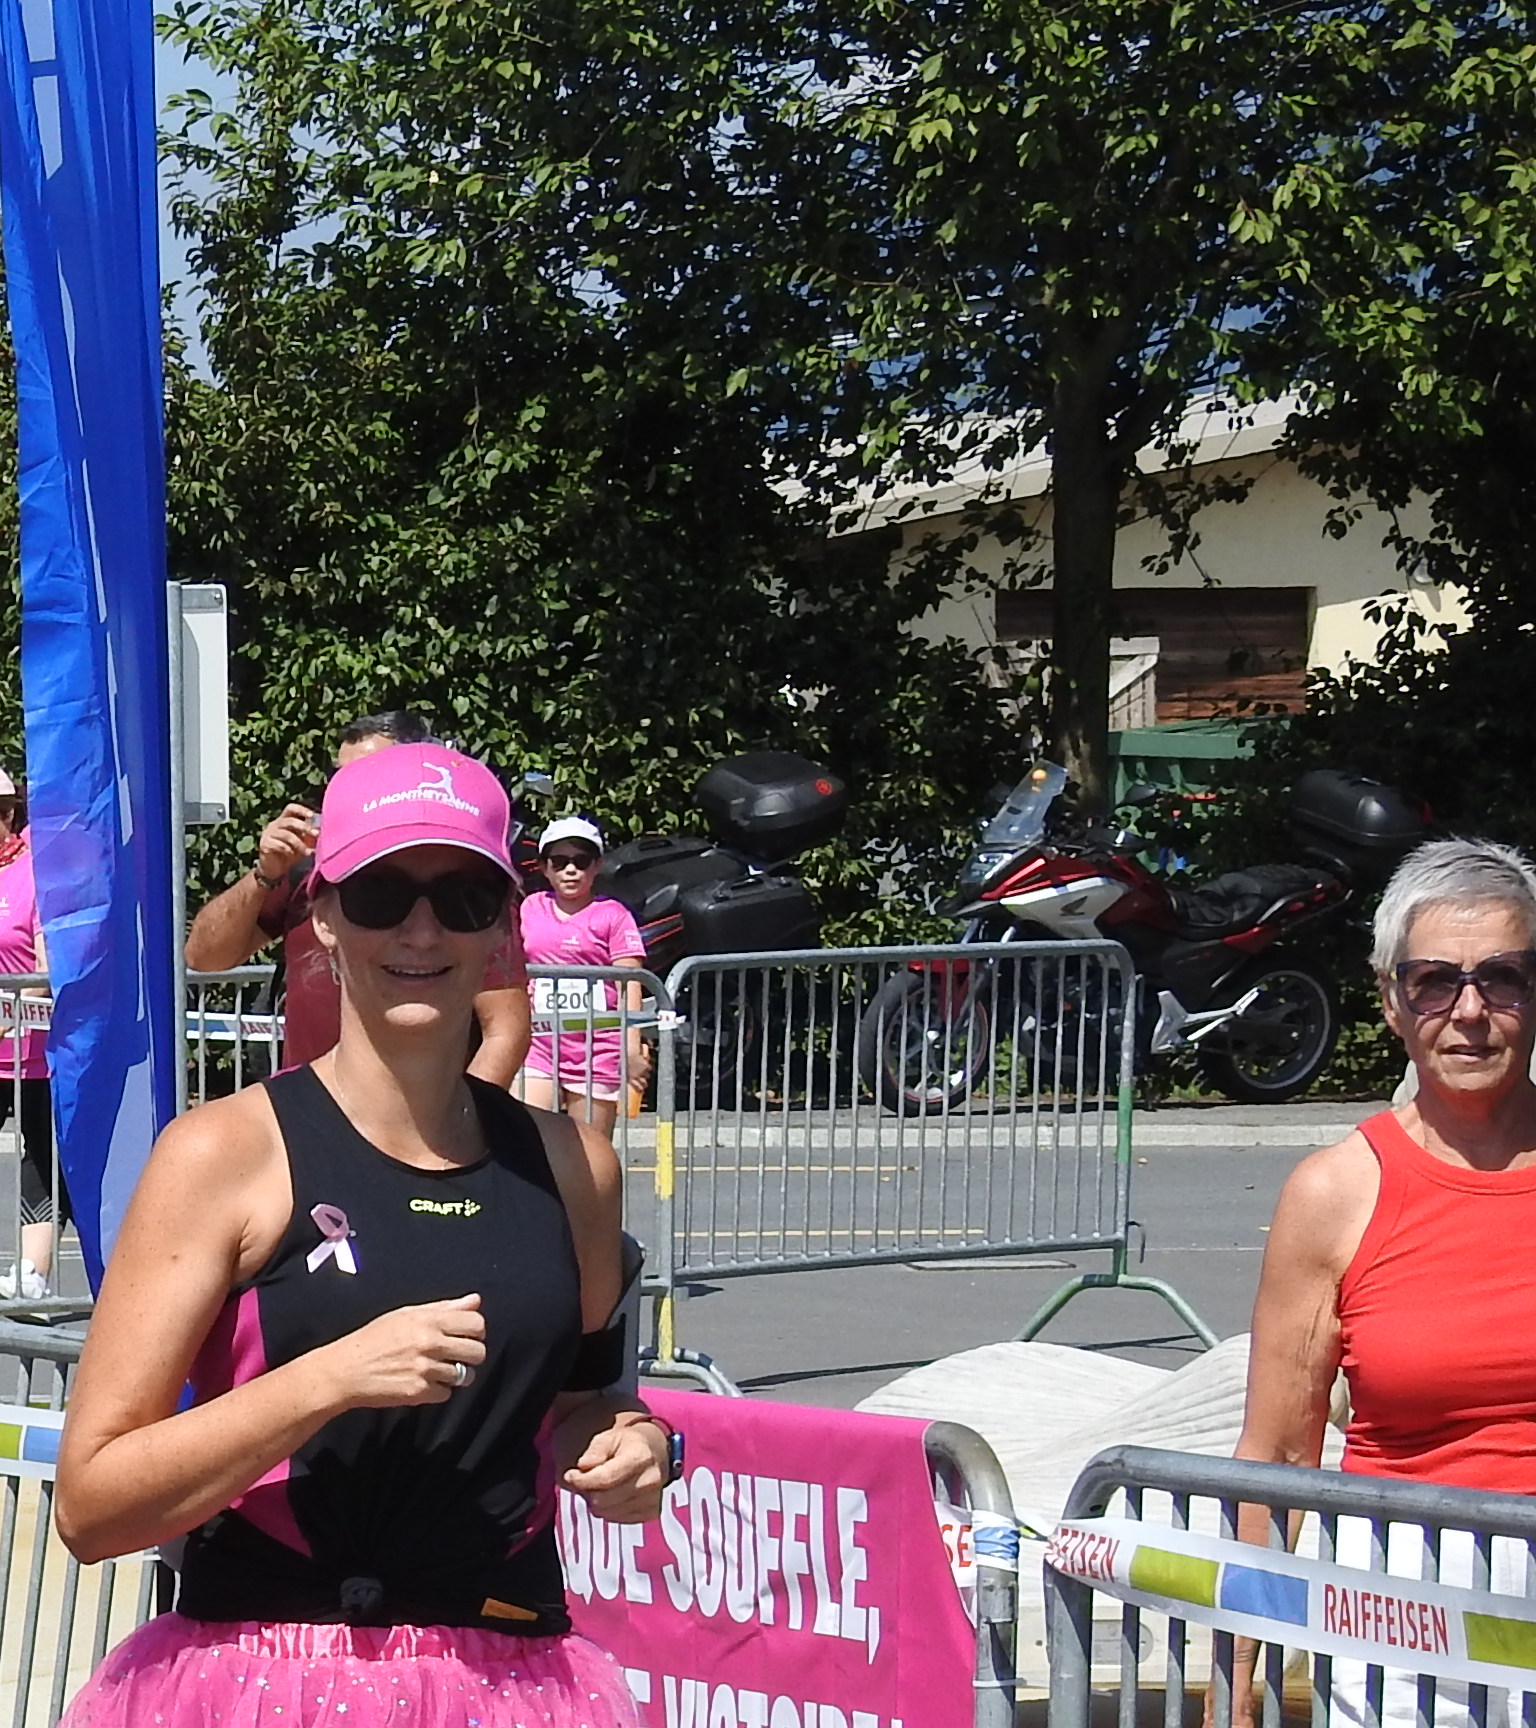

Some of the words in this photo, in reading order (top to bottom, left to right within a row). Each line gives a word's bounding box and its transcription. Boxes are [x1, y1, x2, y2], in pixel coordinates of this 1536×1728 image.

[409, 1199, 464, 1215] CRAFT
[660, 1466, 881, 1665] SOUFFLE,
[1324, 1583, 1449, 1656] RAIFFEISEN
